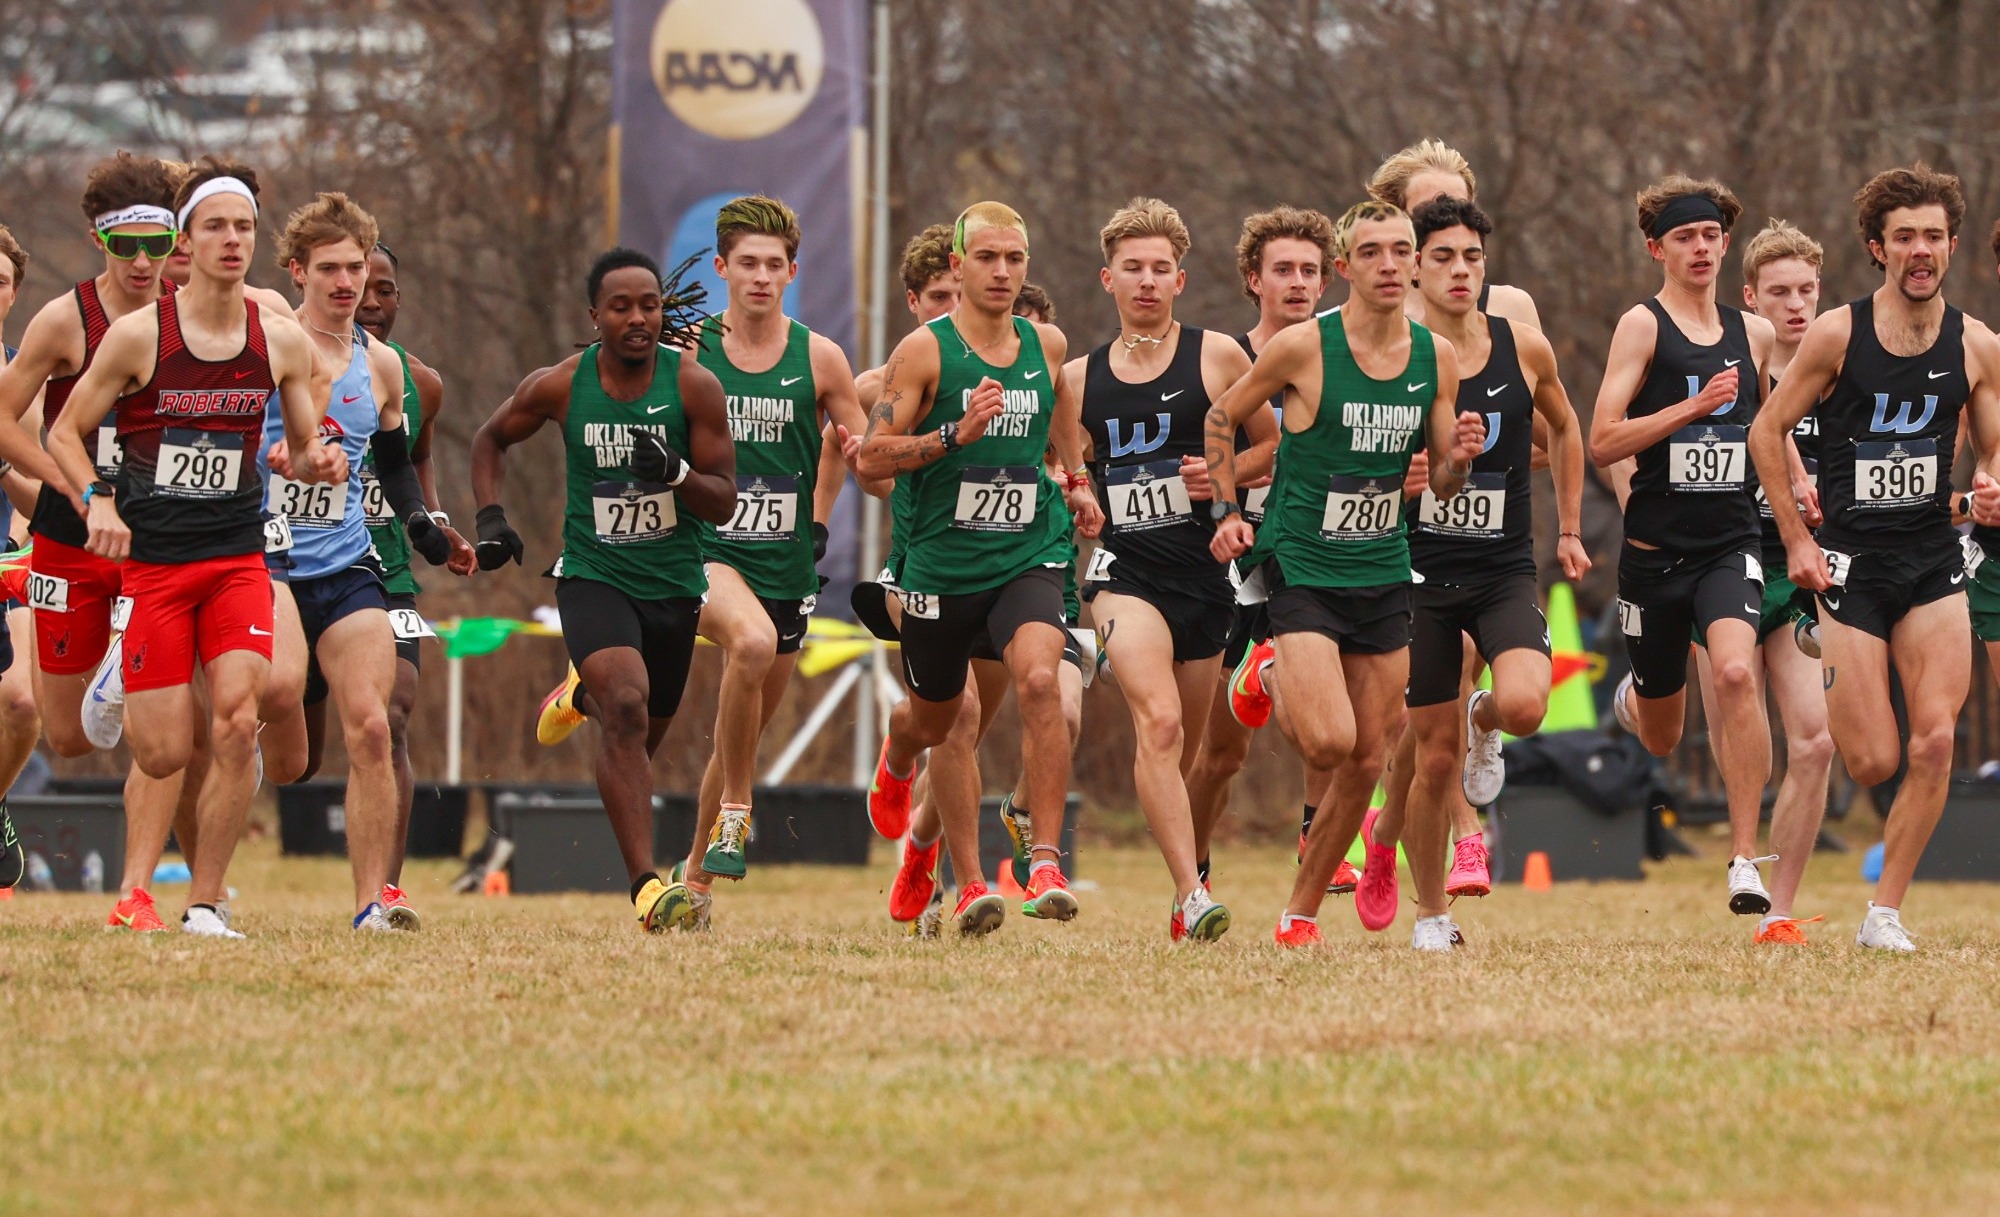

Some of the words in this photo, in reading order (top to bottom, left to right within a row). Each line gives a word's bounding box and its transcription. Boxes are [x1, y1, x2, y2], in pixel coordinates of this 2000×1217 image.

[161, 391, 267, 415] ROBERTS
[725, 395, 794, 422] KLAHOMA
[962, 388, 1039, 414] OHOMA
[1342, 402, 1422, 430] OKLAHOMA
[983, 413, 1032, 437] APTIST
[1350, 428, 1413, 453] BAPTIST
[170, 453, 227, 489] 298
[595, 446, 635, 468] BAPT
[1685, 448, 1734, 482] 397
[1869, 462, 1925, 499] 396
[280, 483, 333, 518] 315
[361, 485, 384, 517] 79
[732, 498, 783, 532] 275
[971, 488, 1023, 523] 278
[1126, 483, 1176, 521] 411
[1337, 498, 1391, 532] 280
[1433, 494, 1491, 529] 399
[269, 517, 291, 546] 31
[608, 500, 662, 535] 273
[901, 592, 928, 615] 78
[398, 610, 423, 634] 27
